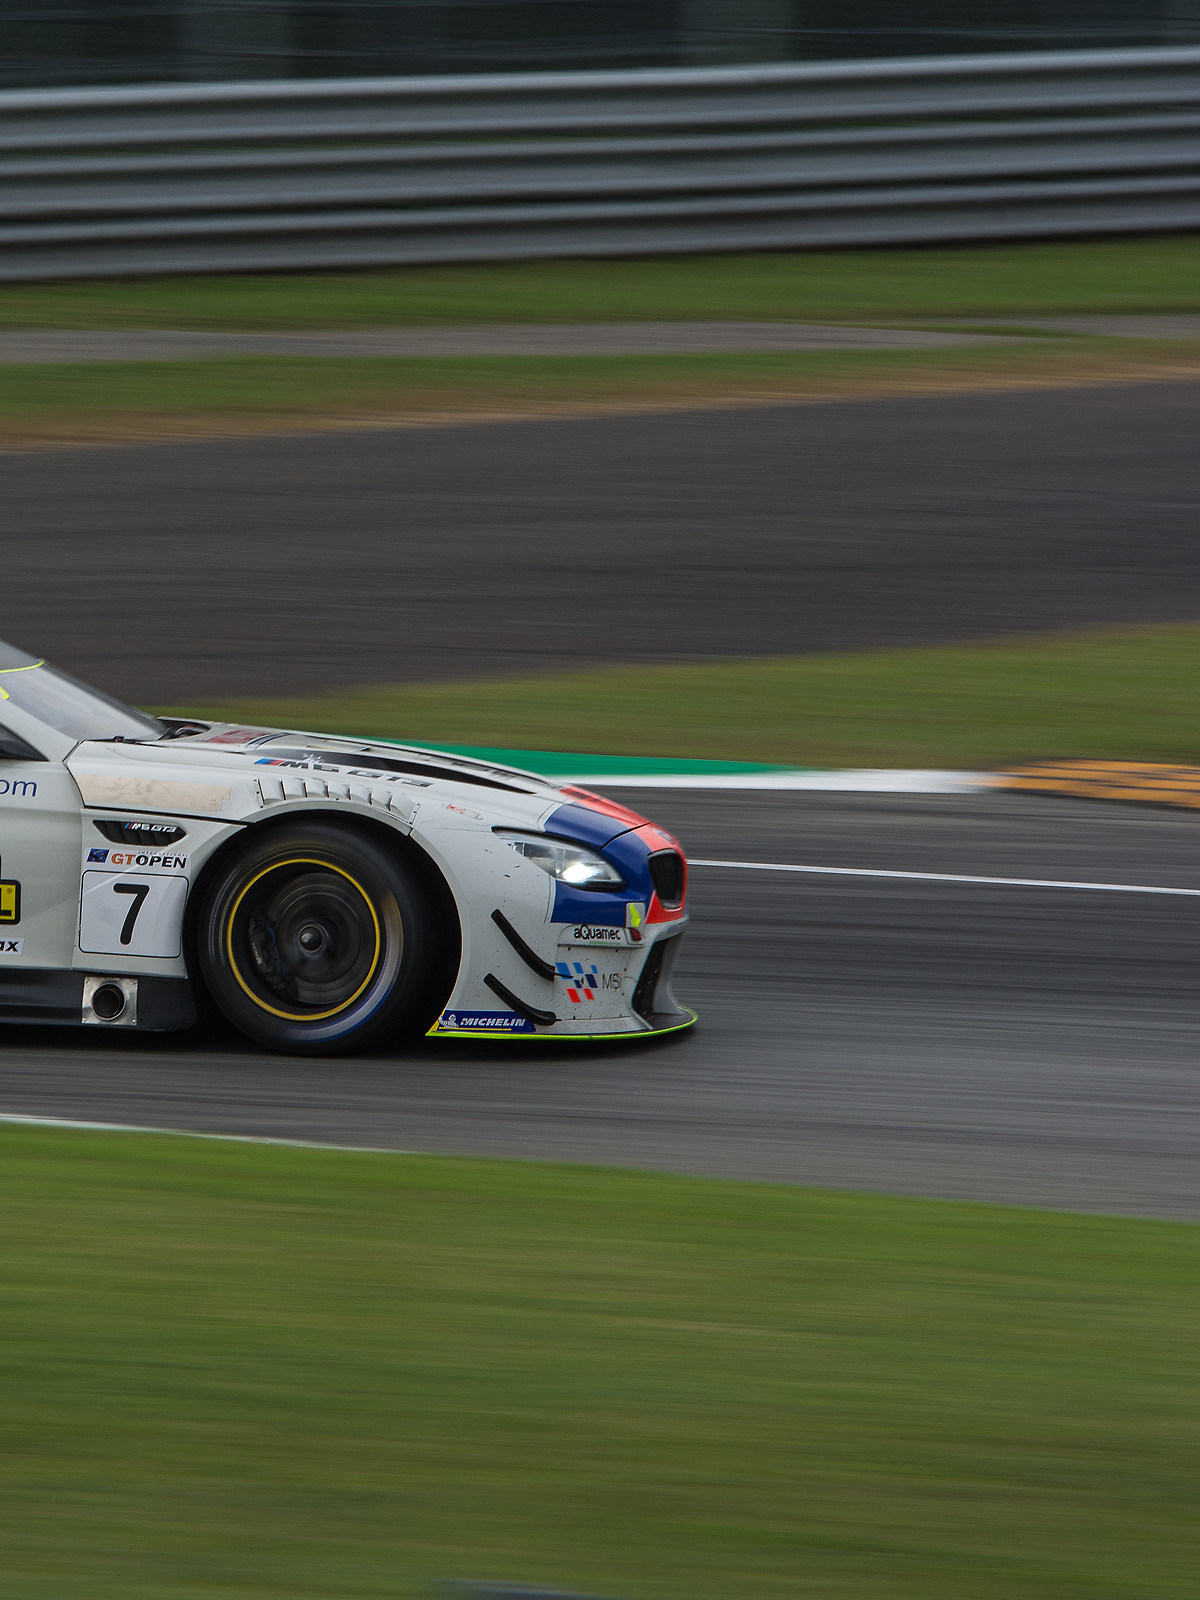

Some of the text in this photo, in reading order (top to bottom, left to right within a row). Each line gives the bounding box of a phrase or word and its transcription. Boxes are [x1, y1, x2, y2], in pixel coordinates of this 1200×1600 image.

[131, 822, 177, 833] M6 GT3
[113, 883, 150, 946] 7
[573, 924, 621, 940] aQuamec
[460, 1017, 526, 1027] MICHELIN
